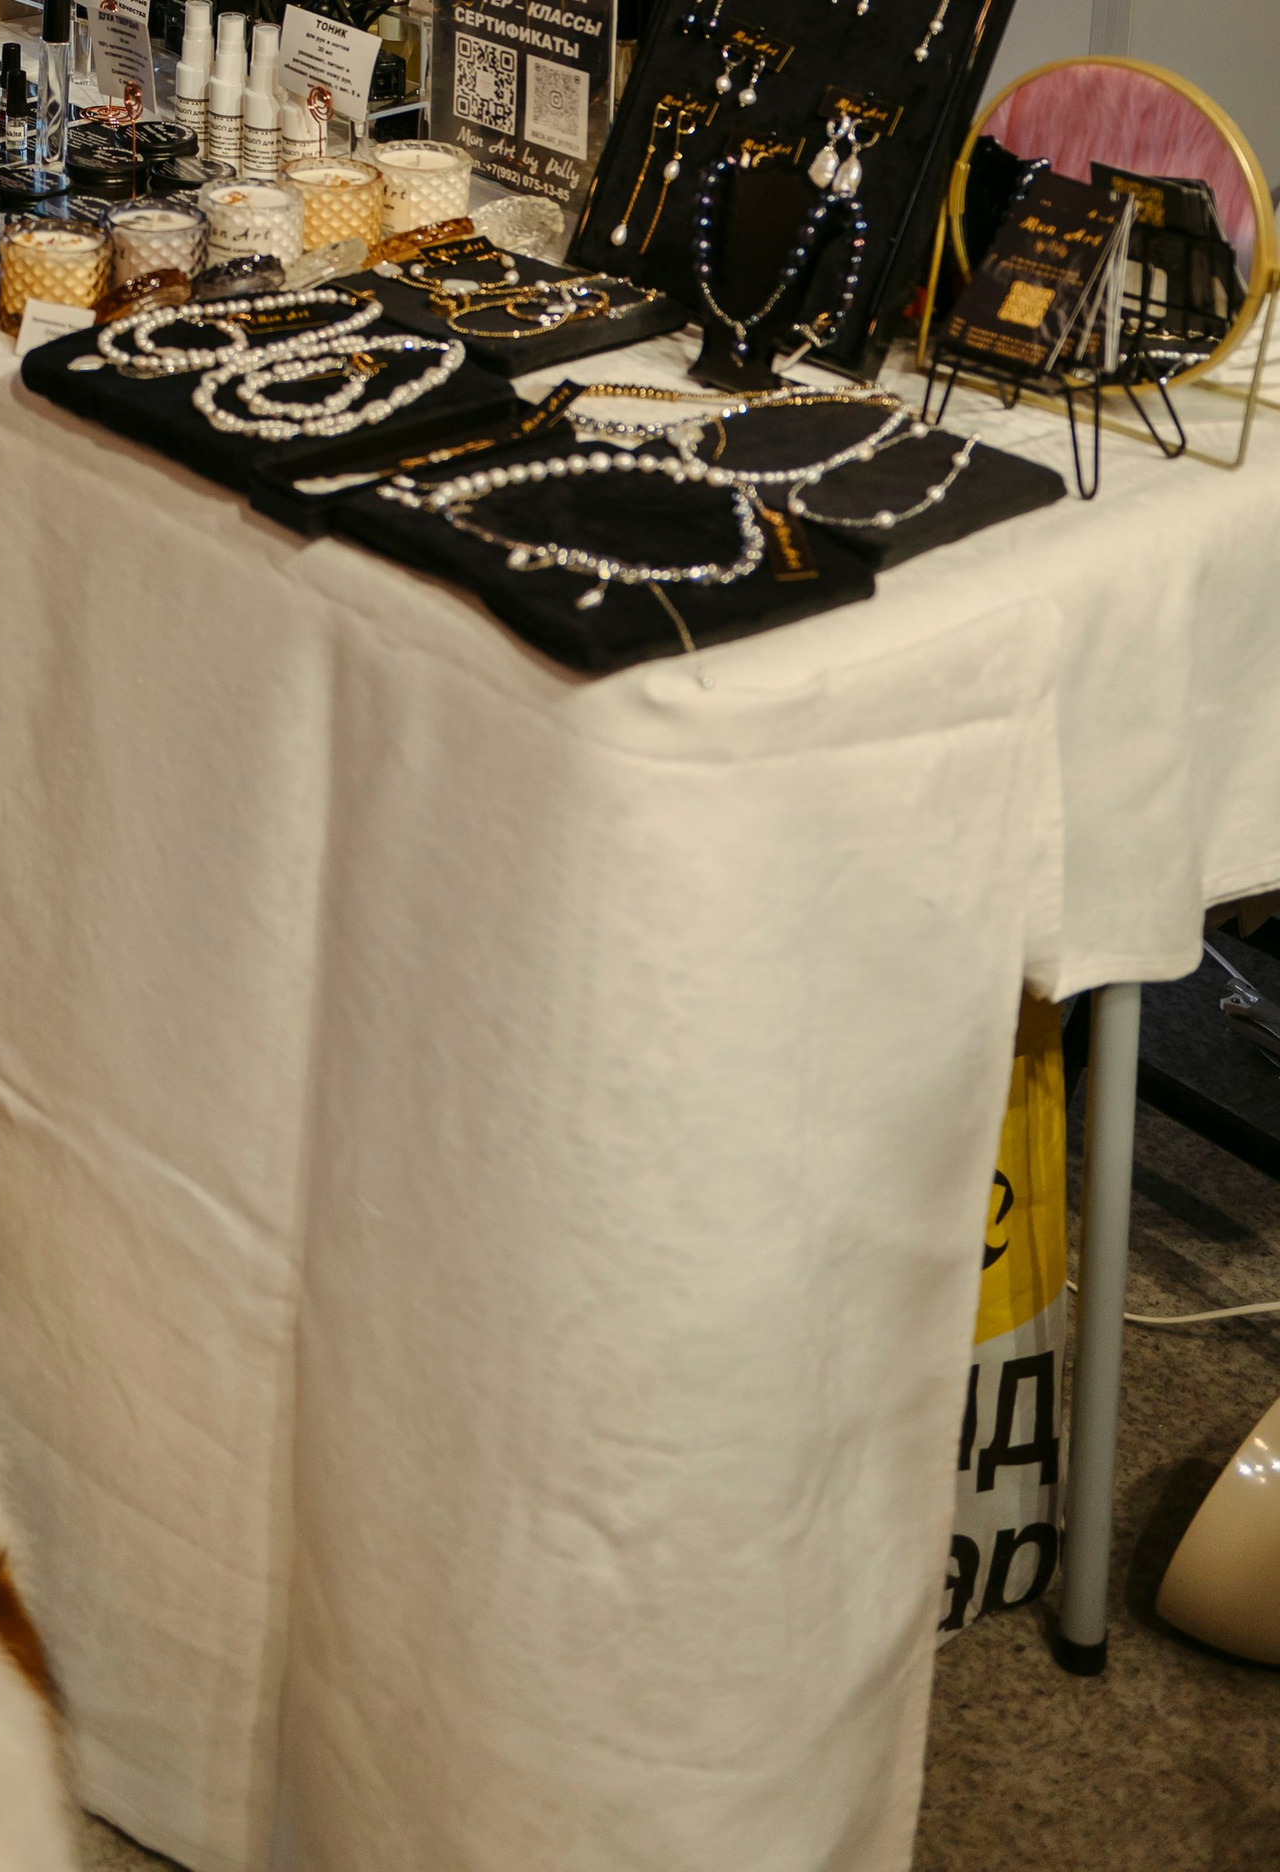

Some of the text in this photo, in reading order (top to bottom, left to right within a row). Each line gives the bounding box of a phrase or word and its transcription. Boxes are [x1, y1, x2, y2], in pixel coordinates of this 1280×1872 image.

[118, 2, 146, 18] качества
[526, 1, 603, 38] КЛАССЫ
[306, 32, 316, 40] для
[315, 19, 349, 39] ТОНИК
[454, 6, 581, 60] СЕРТИФИКАТЫ
[456, 125, 581, 190] Mon Art by Polly
[522, 175, 571, 203] 075-13-85
[232, 228, 270, 242] Art
